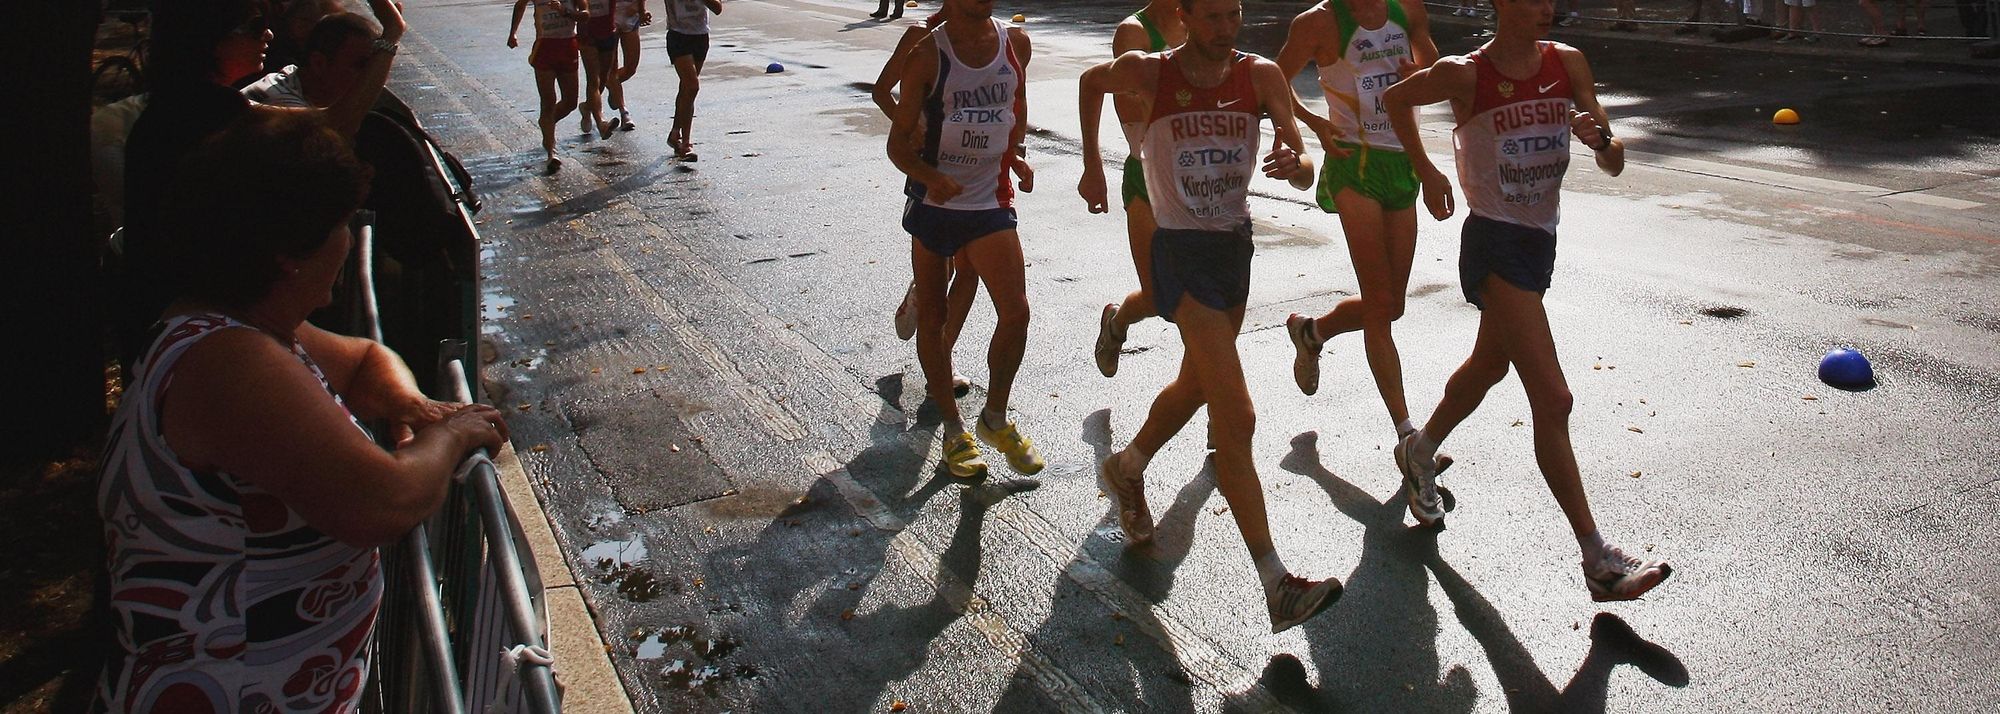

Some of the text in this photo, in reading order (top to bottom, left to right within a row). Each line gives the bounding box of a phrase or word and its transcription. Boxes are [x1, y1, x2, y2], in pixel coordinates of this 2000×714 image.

[1360, 45, 1404, 63] Australia
[1372, 72, 1400, 88] TD
[952, 82, 1008, 109] FRANCE
[963, 109, 1003, 123] TDK
[1493, 102, 1567, 134] RUSSIA
[1170, 114, 1248, 142] RUSSIA
[1363, 121, 1393, 132] berli
[961, 130, 989, 149] Diniz
[1518, 133, 1565, 153] TDK
[939, 151, 978, 165] berlin
[1194, 148, 1244, 166] TDK
[1181, 171, 1244, 201] Kirdyapkin
